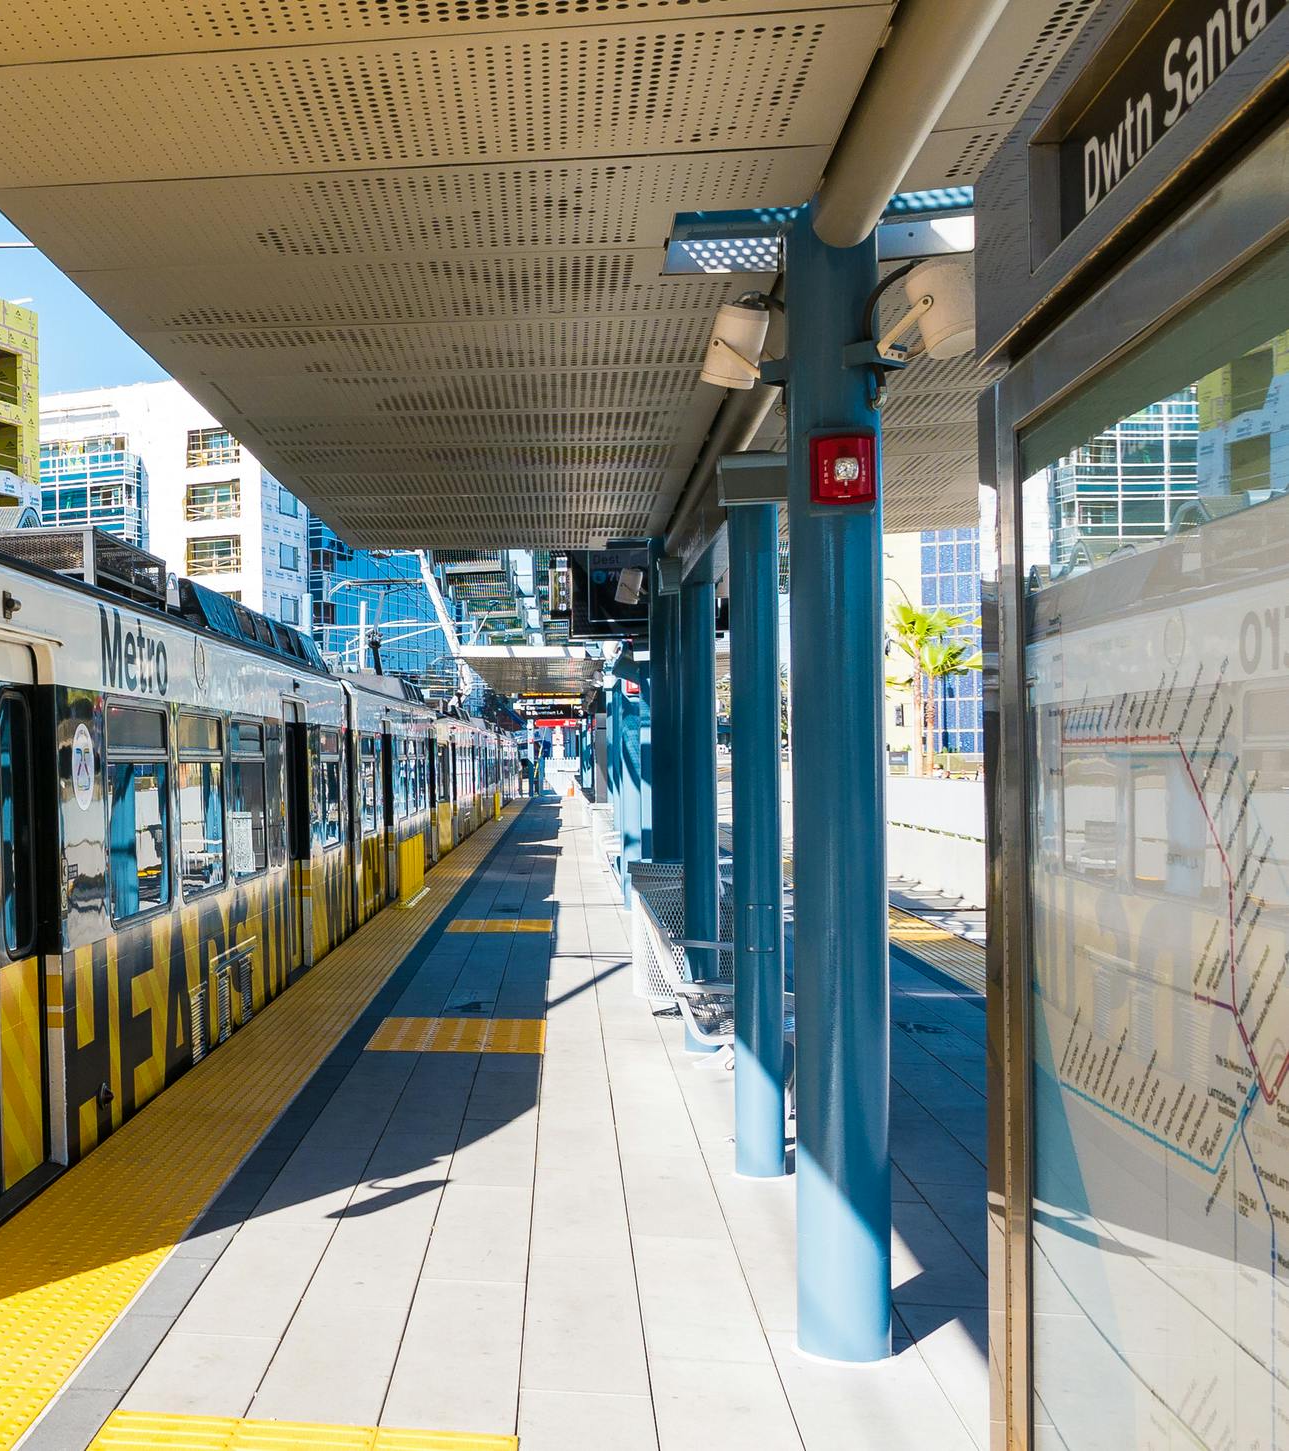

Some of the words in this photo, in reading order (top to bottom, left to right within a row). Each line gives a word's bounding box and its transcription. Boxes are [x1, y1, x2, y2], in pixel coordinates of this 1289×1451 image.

[1084, 92, 1152, 215] Dwtn
[1163, 0, 1267, 128] Santa
[97, 602, 169, 697] Metro
